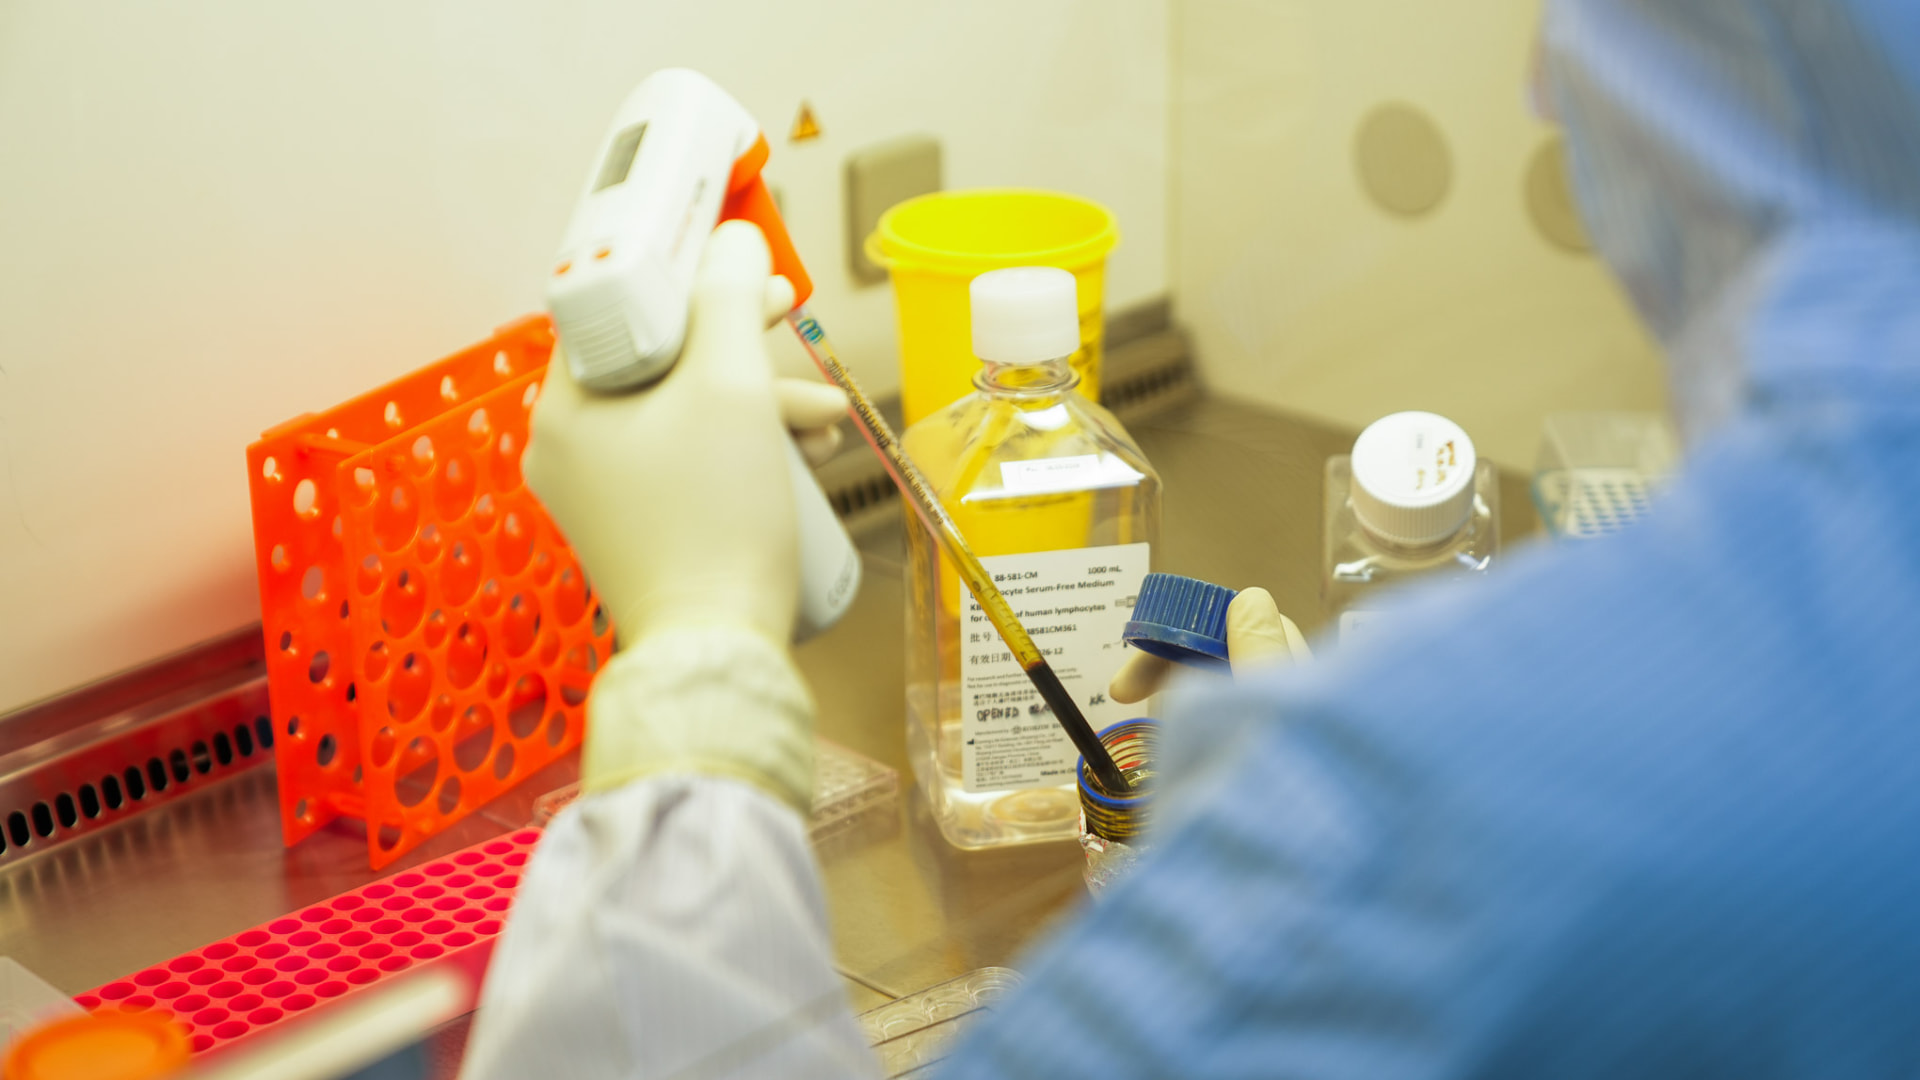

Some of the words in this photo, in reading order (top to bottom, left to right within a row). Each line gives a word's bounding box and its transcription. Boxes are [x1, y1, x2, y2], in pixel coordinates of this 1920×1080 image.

[995, 571, 1038, 581] 88-581-CM
[1088, 566, 1106, 574] 1000
[1026, 582, 1075, 594] Serum-Free
[1078, 580, 1114, 589] Medium
[1025, 608, 1053, 617] human
[1055, 604, 1106, 616] lymphocytes
[970, 652, 1010, 664] 有效日期
[977, 707, 1020, 722] OPENED
